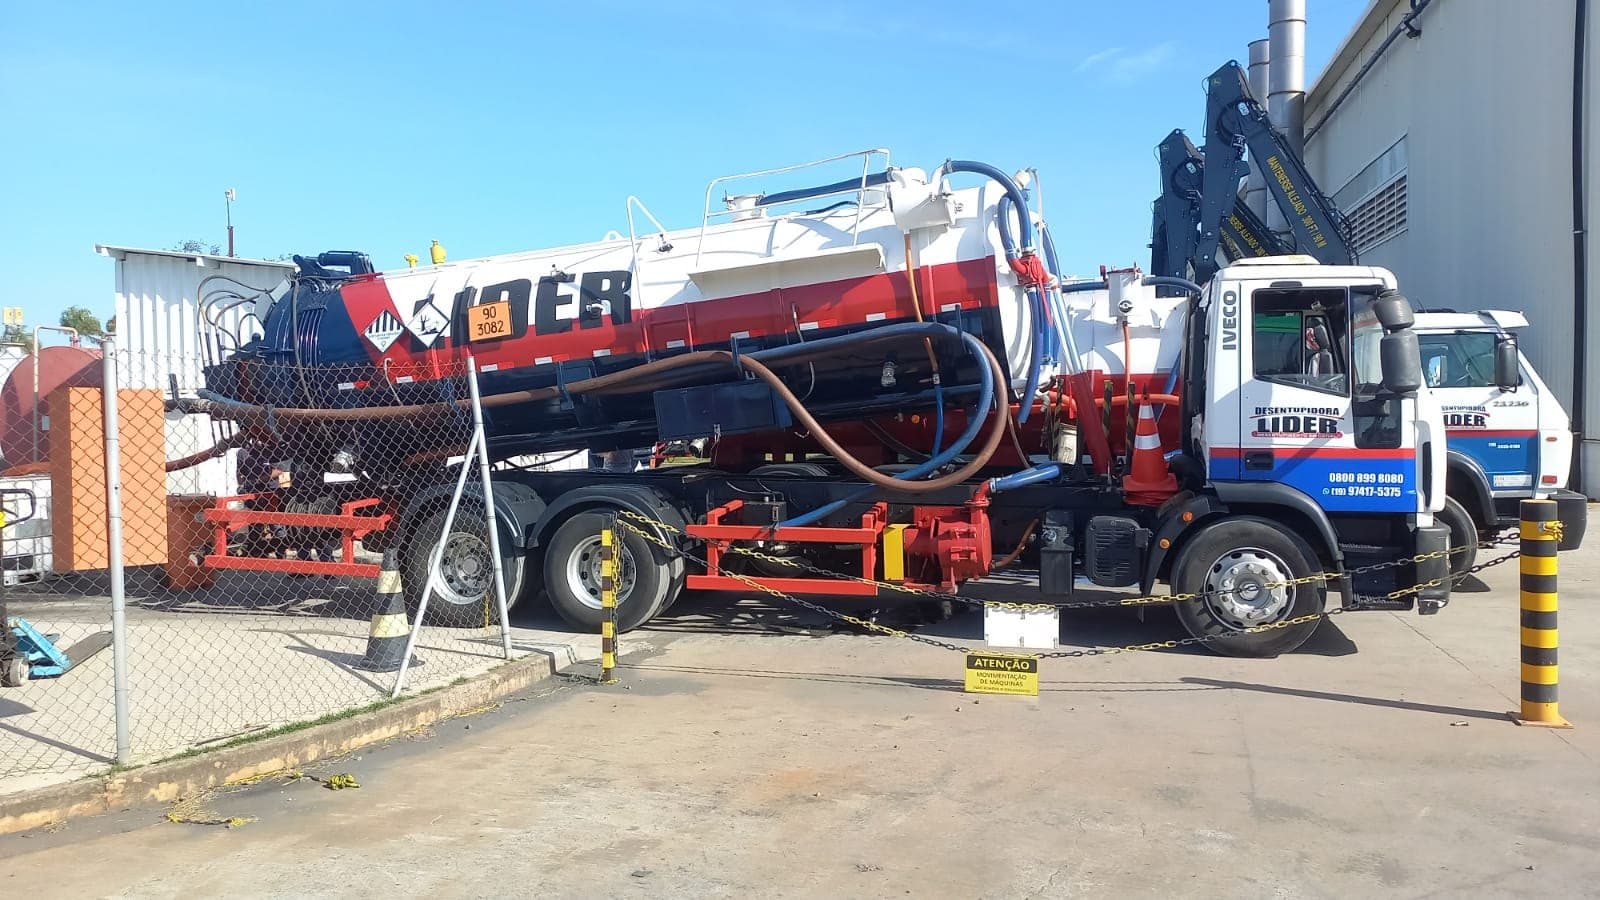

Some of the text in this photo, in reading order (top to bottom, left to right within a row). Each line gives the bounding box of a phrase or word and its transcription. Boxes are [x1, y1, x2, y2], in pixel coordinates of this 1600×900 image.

[482, 306, 497, 320] 90
[1222, 290, 1237, 350] IVECO
[477, 320, 505, 336] 3082
[1255, 406, 1340, 415] DESENTUPIDORA
[1257, 416, 1338, 434] LIDER
[1443, 414, 1486, 426] IDER
[1329, 472, 1404, 484] 0800 899 8080
[1331, 486, 1401, 497] (19) 97417-5375
[974, 658, 1030, 671] ATENÇÃO
[976, 671, 1028, 681] MOVIMENTAÇÃO
[989, 679, 1024, 687] MÁQUINAS
